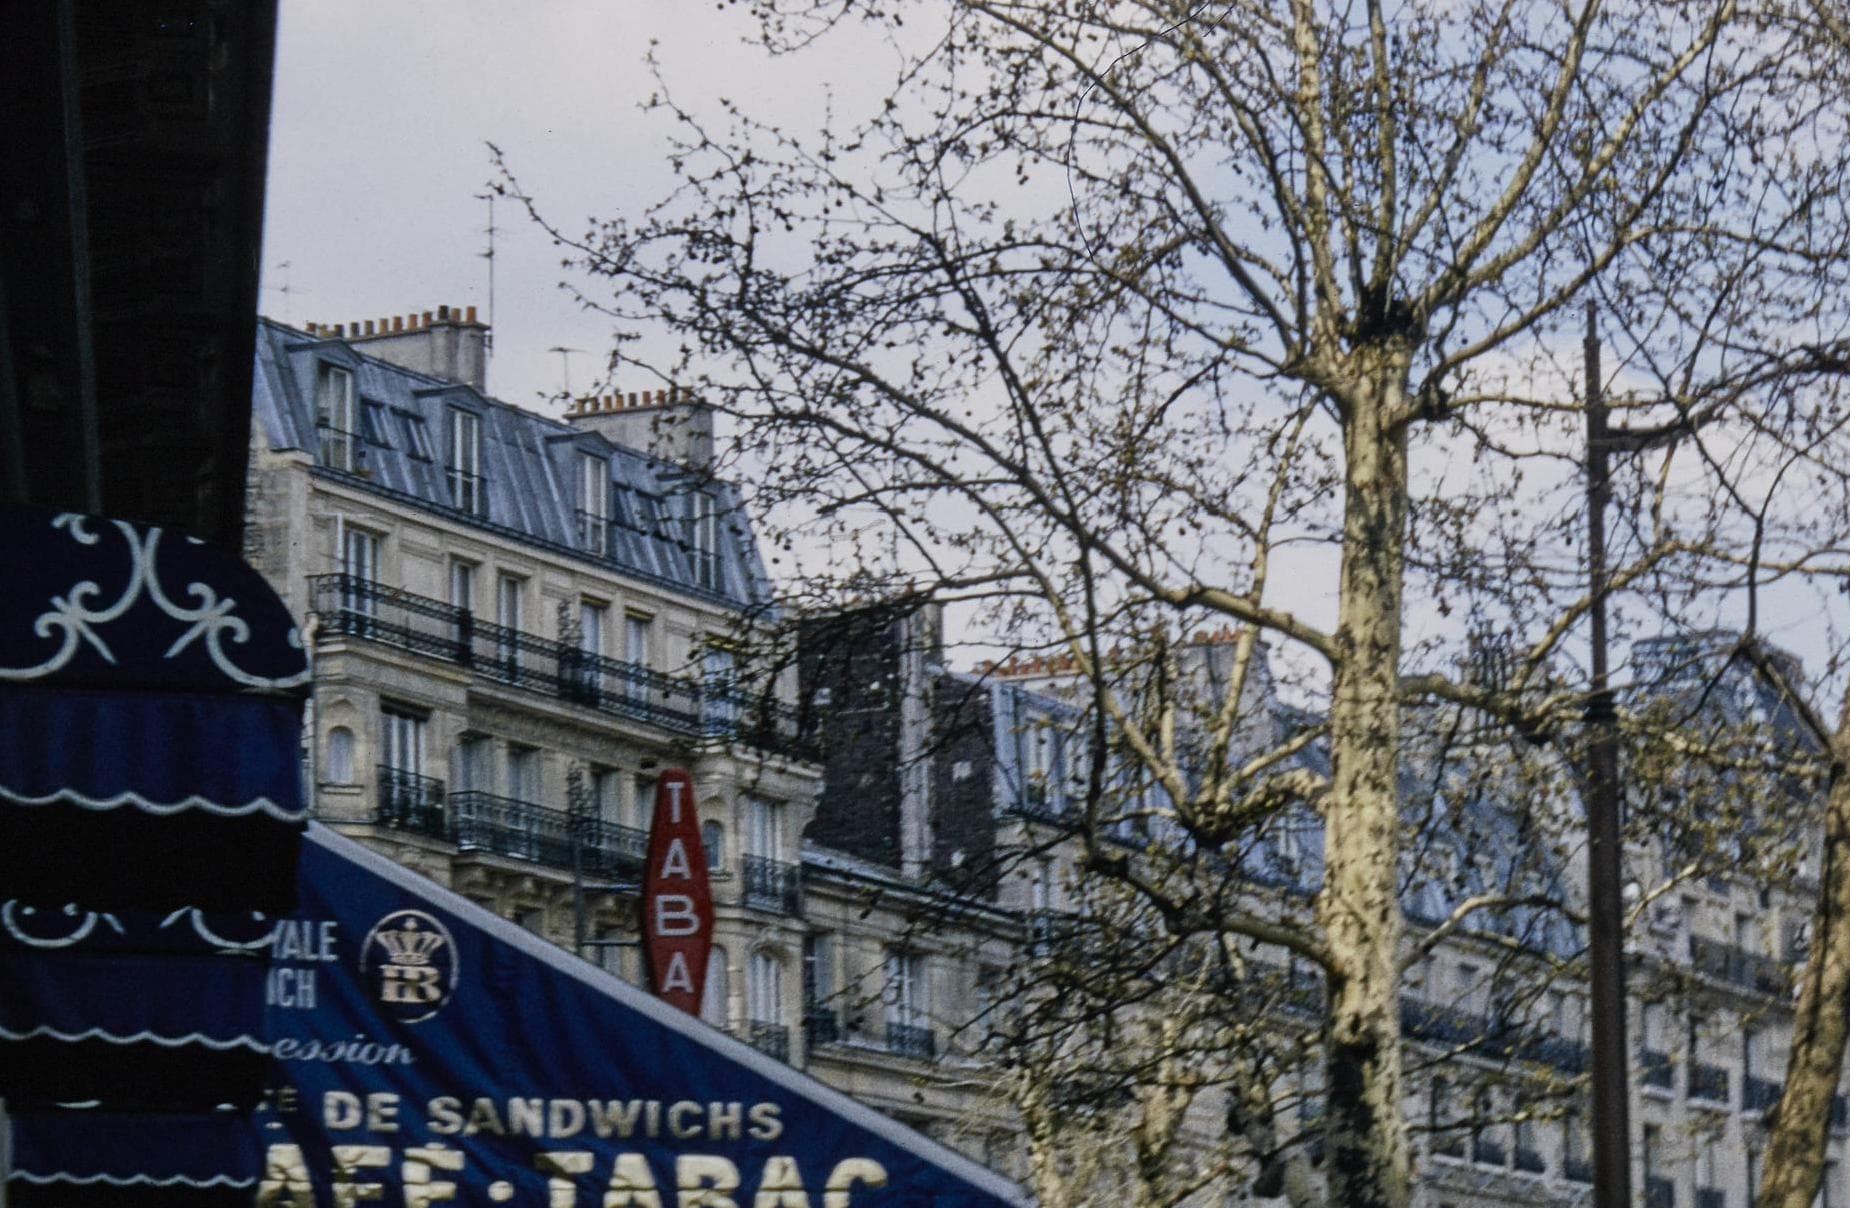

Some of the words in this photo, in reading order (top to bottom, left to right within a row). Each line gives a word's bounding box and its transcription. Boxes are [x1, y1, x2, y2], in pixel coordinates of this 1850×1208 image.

[655, 781, 700, 993] TABA
[265, 967, 317, 1009] ICH
[271, 1033, 416, 1064] ession
[323, 1090, 401, 1132] DE
[426, 1095, 784, 1142] SANDWICHS
